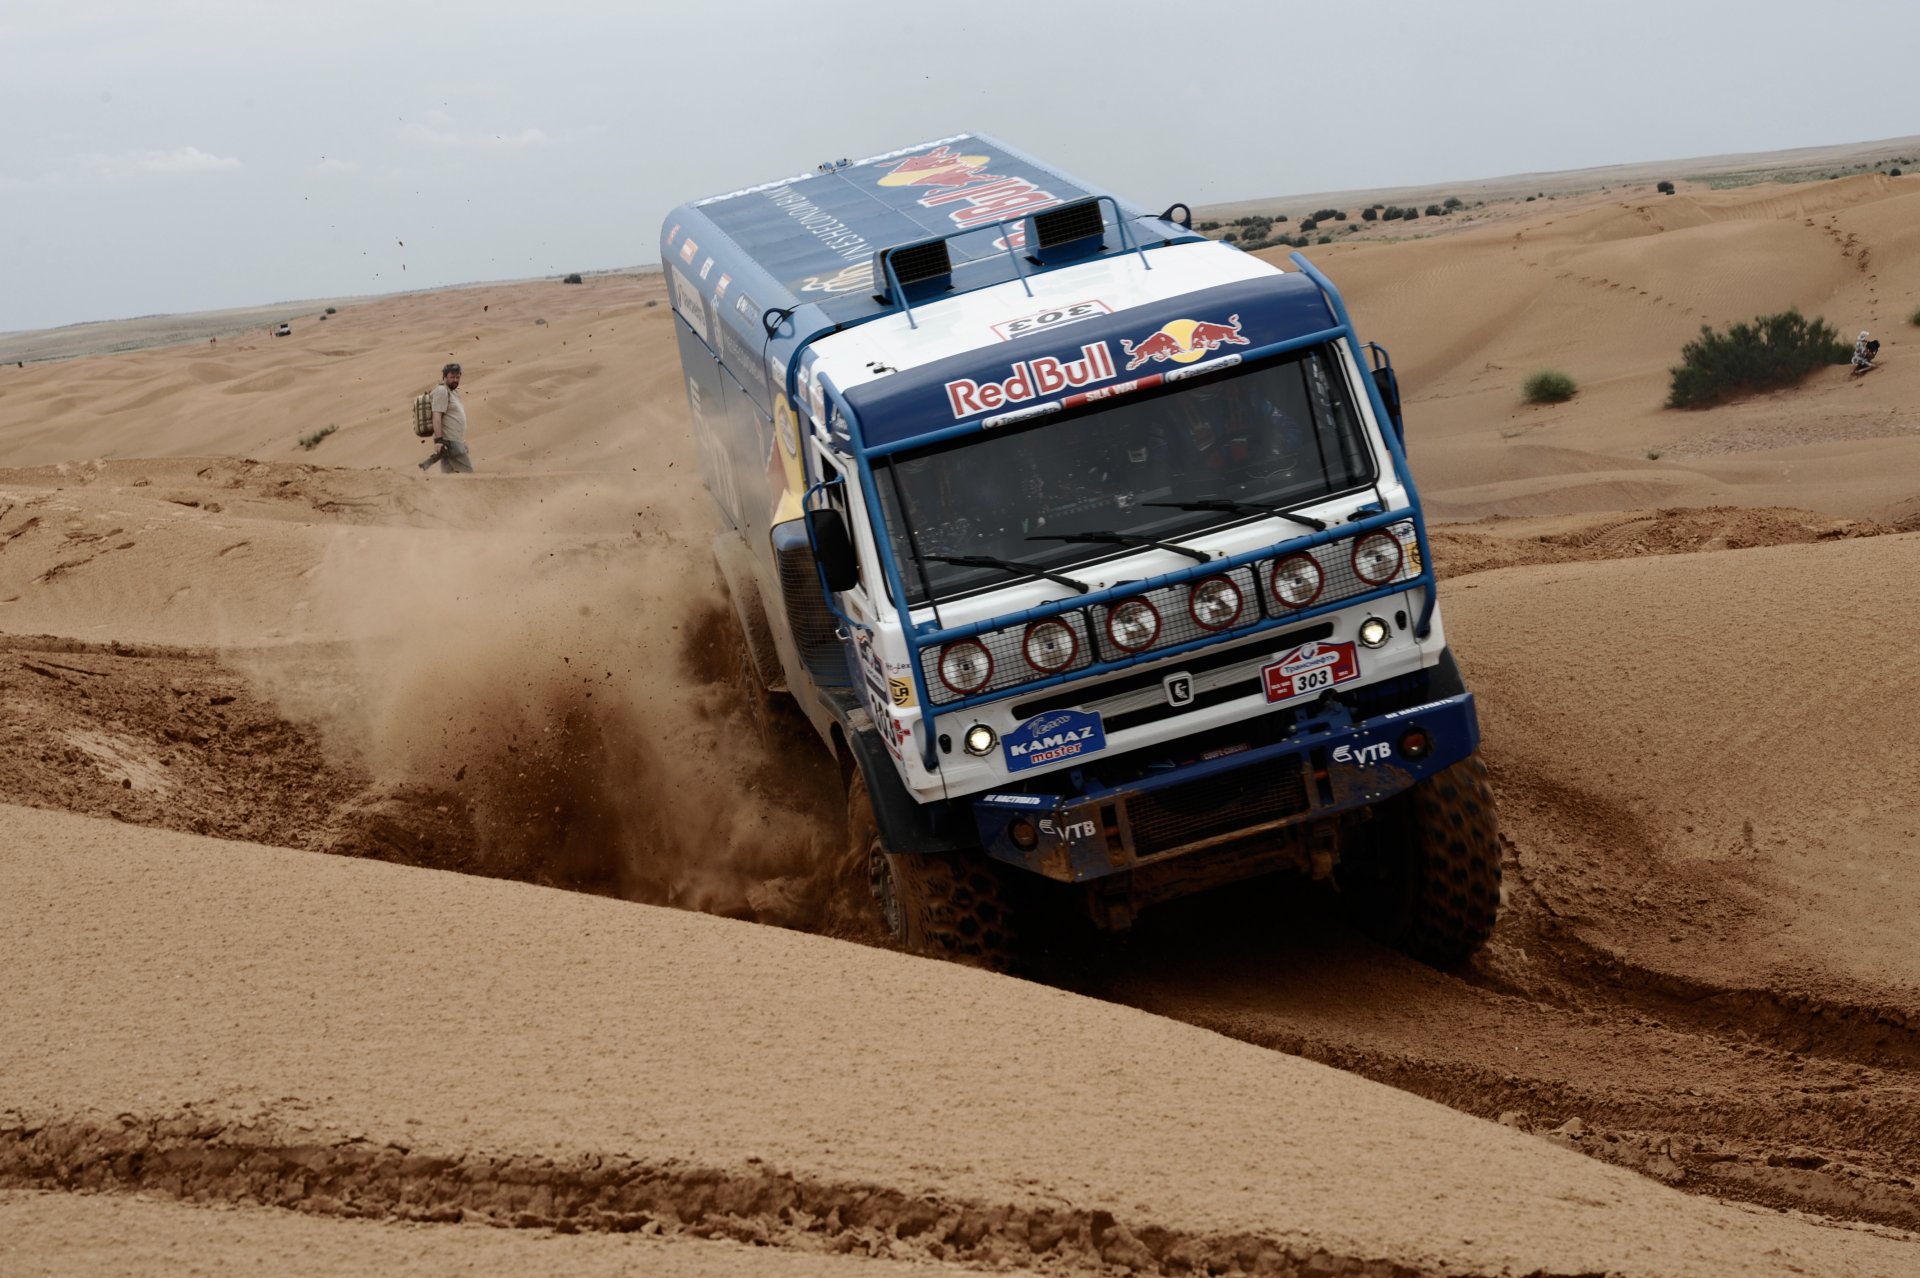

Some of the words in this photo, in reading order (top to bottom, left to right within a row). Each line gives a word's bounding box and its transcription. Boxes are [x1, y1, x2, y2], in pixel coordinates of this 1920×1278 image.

[1008, 303, 1093, 331] 303
[944, 362, 1035, 419] Red
[1030, 342, 1117, 396] Bull
[1086, 385, 1112, 403] SILK
[1113, 379, 1139, 397] WAY
[1298, 670, 1328, 691] 303
[1027, 715, 1072, 738] Team
[1010, 726, 1095, 757] KAMAZ
[1031, 742, 1082, 764] master
[1353, 742, 1392, 764] VTB
[1056, 820, 1097, 841] VTB
